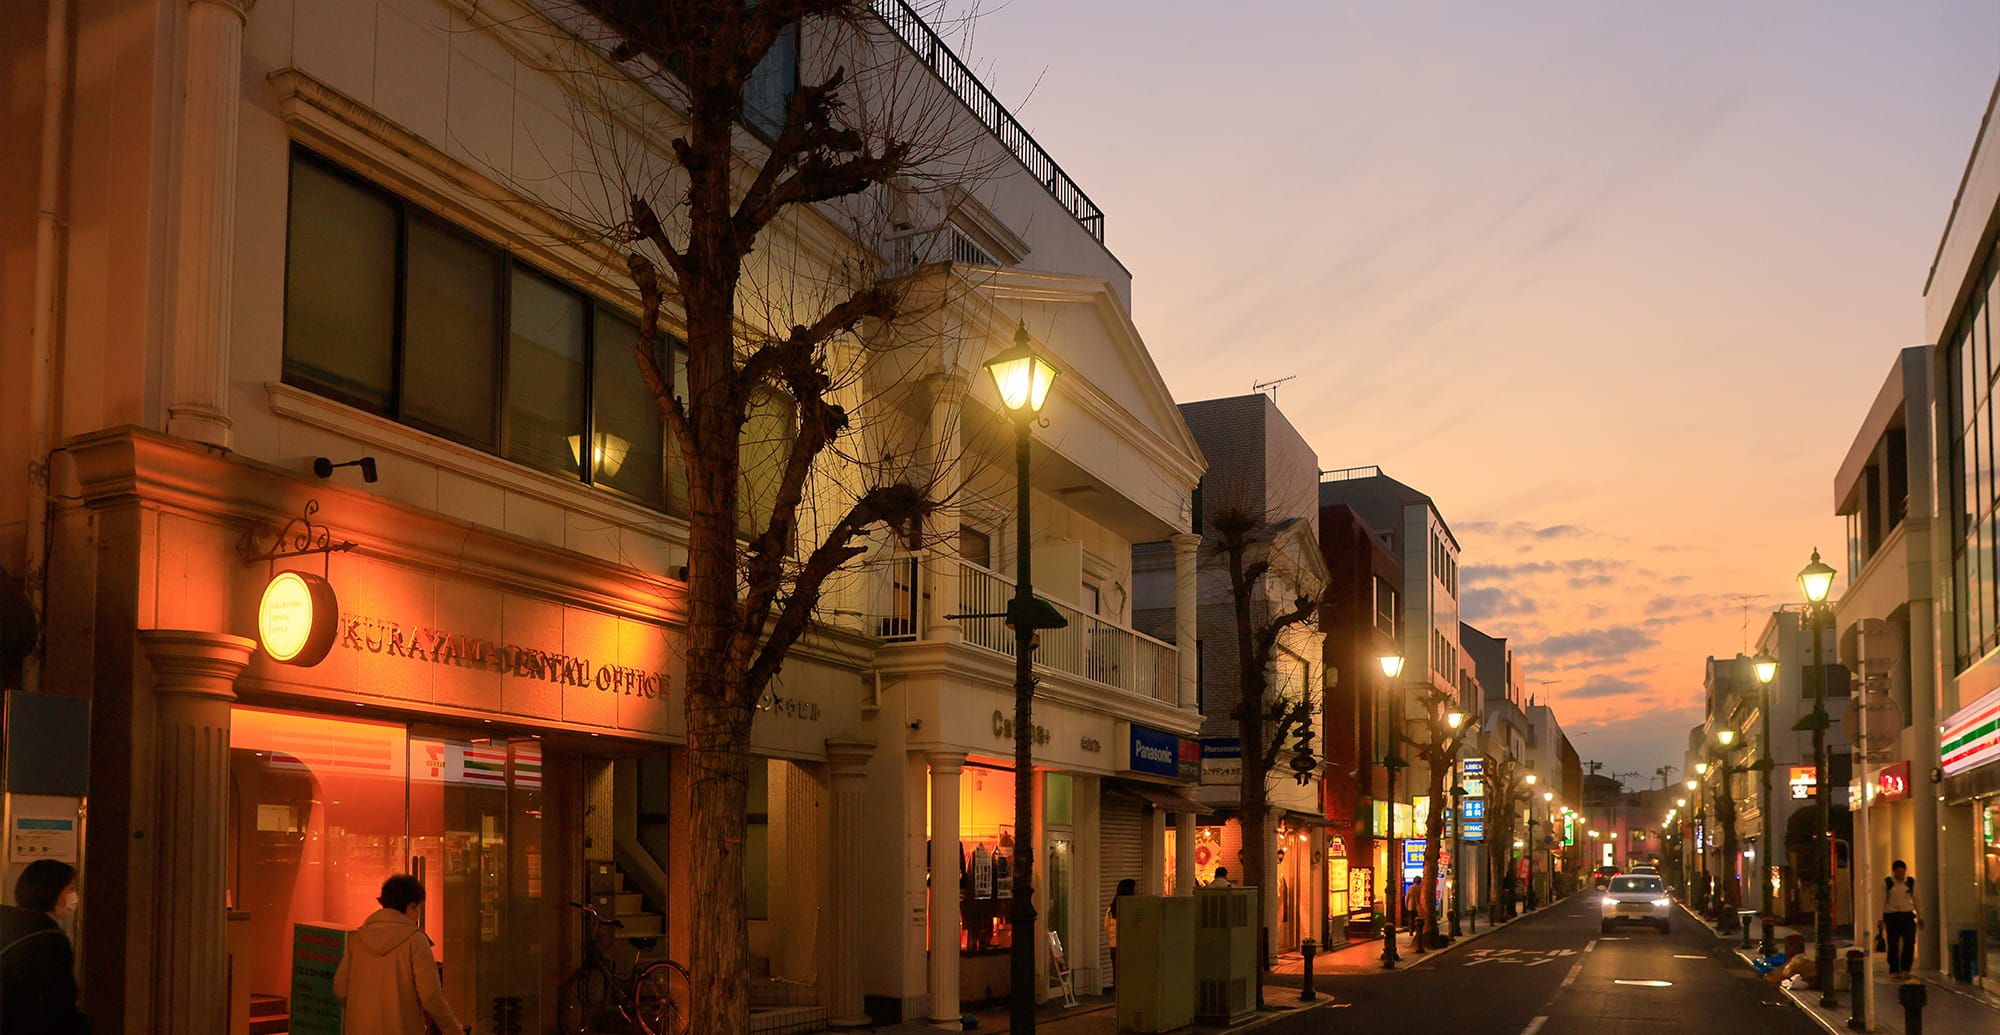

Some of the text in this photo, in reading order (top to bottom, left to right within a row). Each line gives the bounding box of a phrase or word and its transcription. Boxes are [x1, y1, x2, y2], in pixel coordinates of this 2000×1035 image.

[497, 643, 597, 688] DENTAL
[596, 663, 671, 699] OFFICE
[1135, 739, 1172, 763] Panasonic
[1204, 744, 1240, 753] Panasoni
